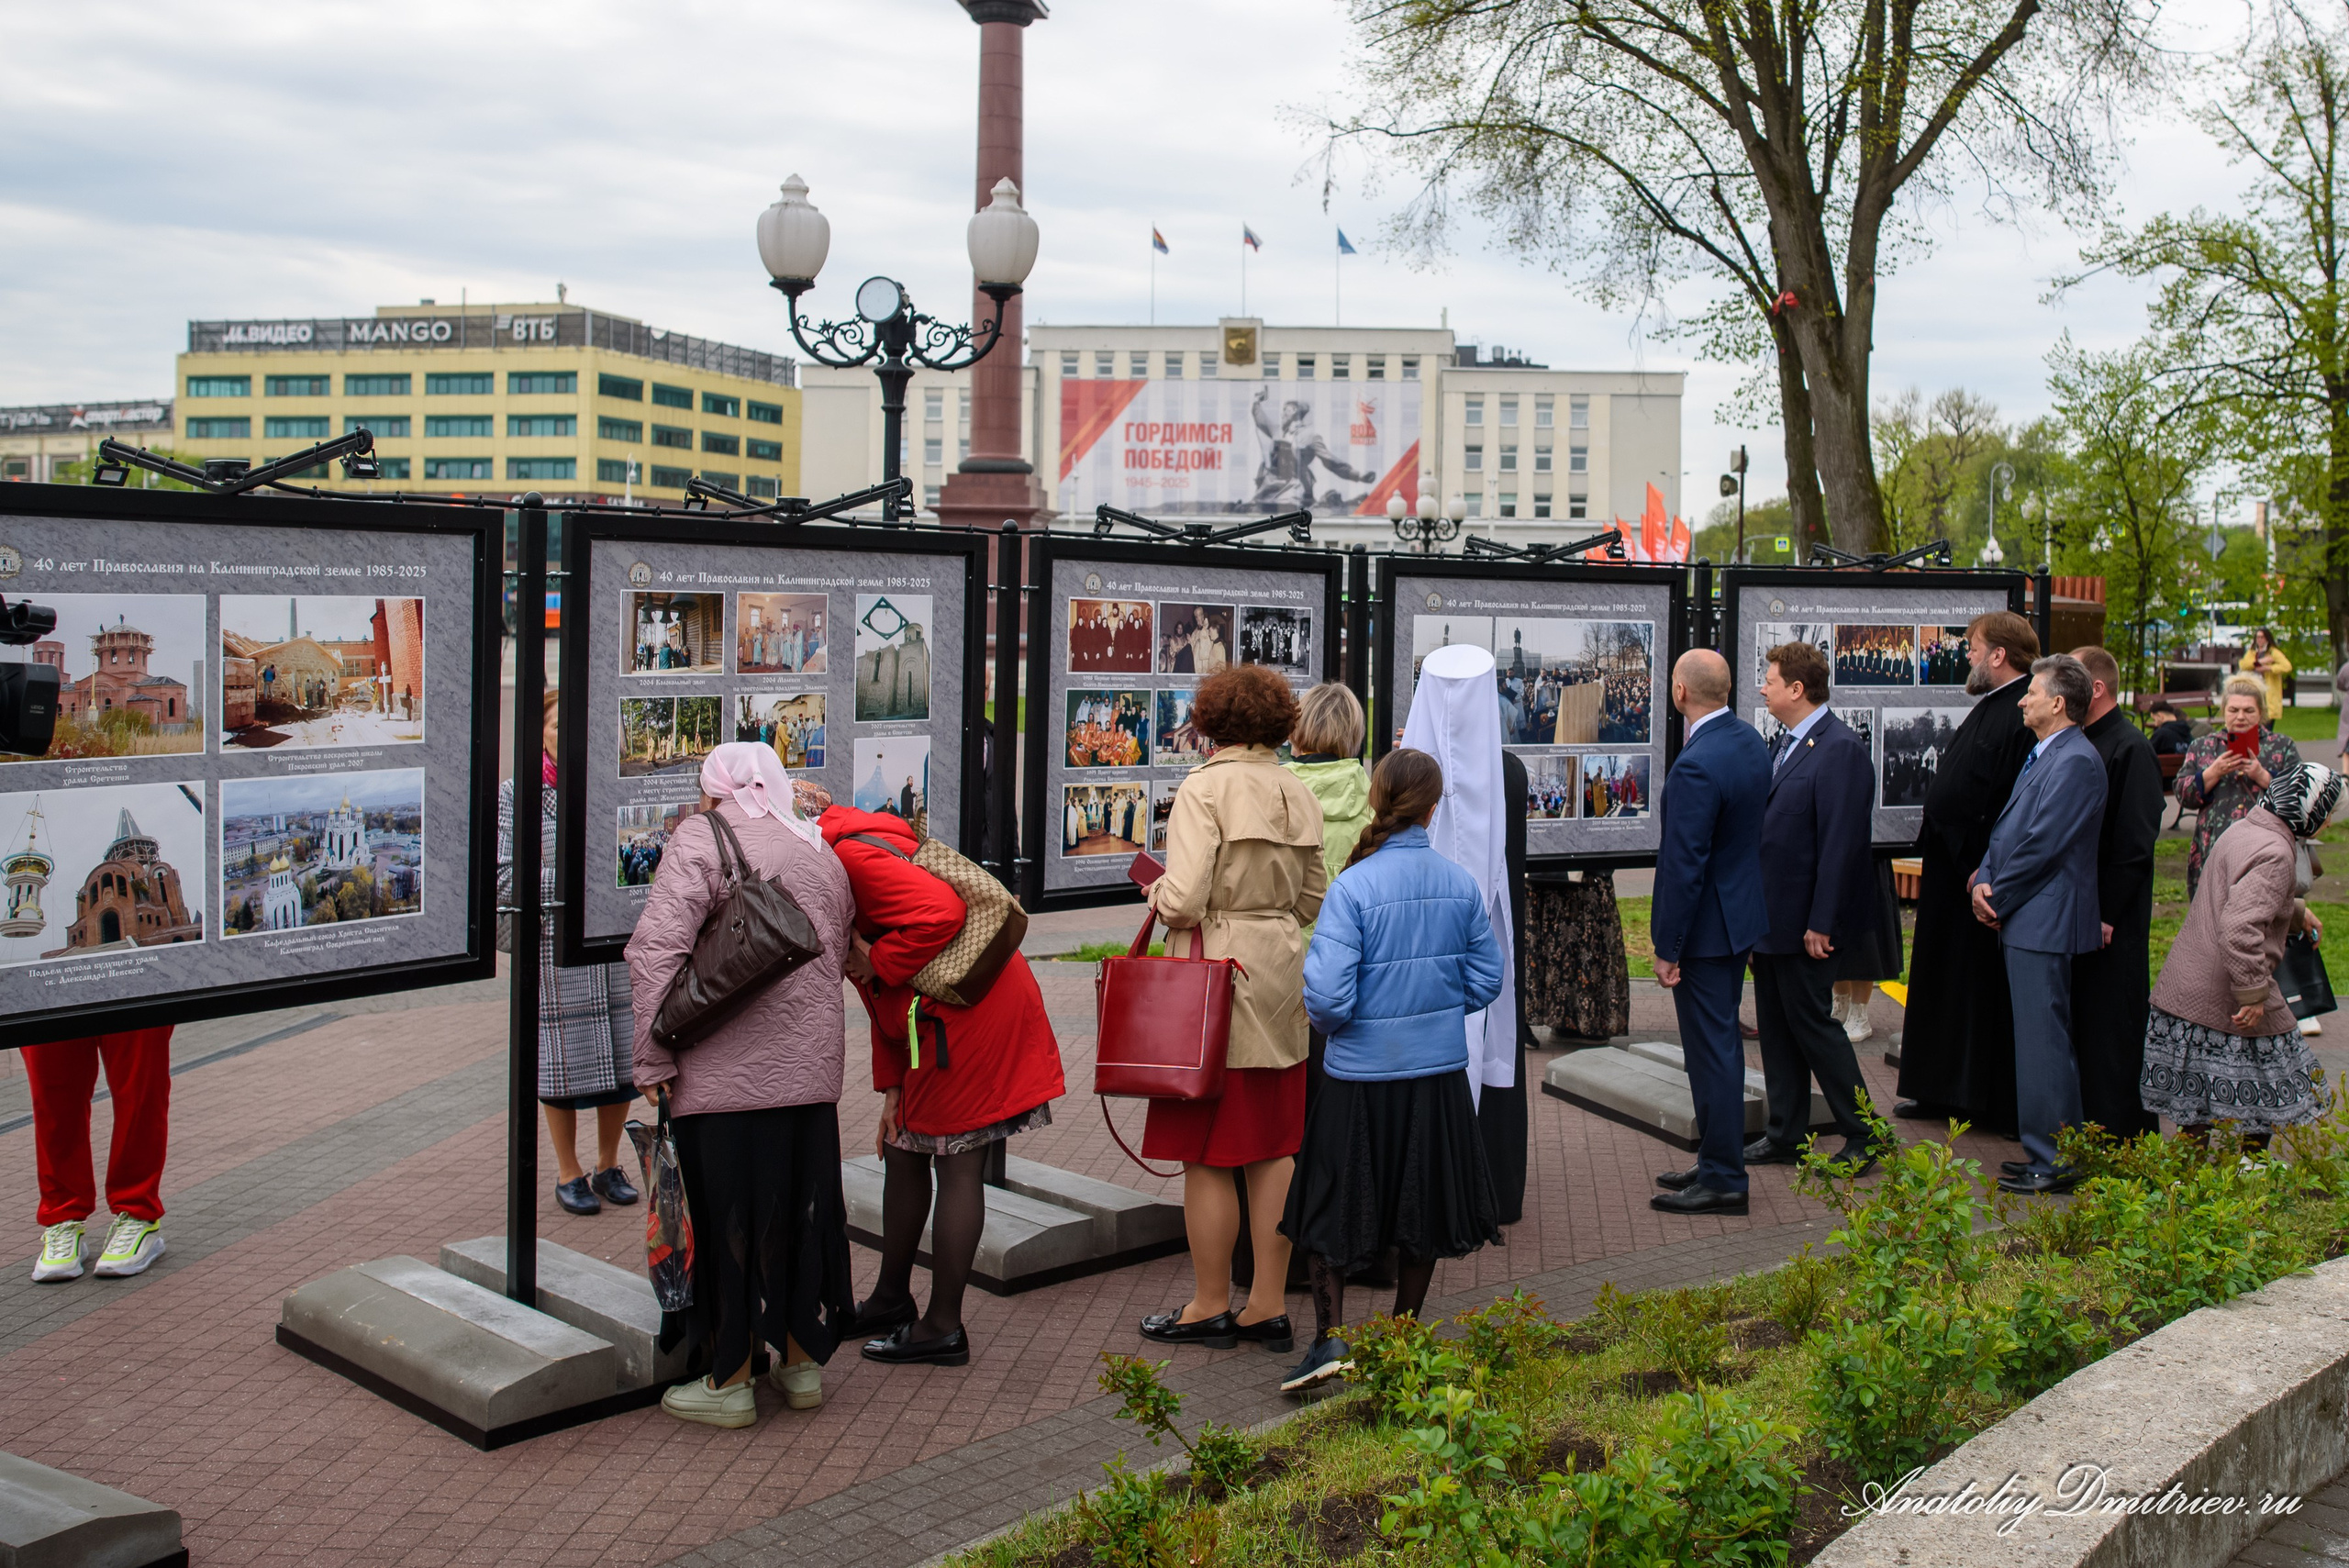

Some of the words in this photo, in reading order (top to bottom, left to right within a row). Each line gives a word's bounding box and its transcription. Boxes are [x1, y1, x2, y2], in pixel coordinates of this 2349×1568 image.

[350, 320, 452, 343] MANGO
[512, 318, 555, 341] ВТБ
[1124, 422, 1232, 446] ГОРДИМСЯ
[1124, 447, 1222, 473] ПОБЕДОЙ!
[34, 557, 54, 572] 40
[59, 562, 87, 572] лет
[93, 559, 184, 575] Православия
[189, 563, 205, 573] на
[210, 562, 320, 578] Калининградской
[325, 566, 362, 576] земле
[366, 564, 427, 577] 1985-2025
[659, 571, 673, 583] 40
[676, 574, 695, 583] лет
[698, 572, 760, 586] Православия
[763, 576, 774, 584] на
[778, 574, 854, 587] Калининградской
[886, 577, 930, 588] 1985-2025
[1107, 581, 1117, 590] 40
[1135, 583, 1179, 594] Православия
[1192, 585, 1248, 597] Калининградской
[1272, 589, 1304, 599] 1985-2025
[1447, 599, 1457, 607] 40
[1475, 600, 1519, 610] Православия
[1531, 601, 1588, 612] Калининградской
[1612, 604, 1646, 613] 1985-2025
[1789, 605, 1799, 613] 40
[1816, 605, 1859, 615] Православия
[1871, 606, 1928, 616] Калининградской
[1952, 606, 1986, 615] 1985-2025
[268, 753, 322, 763] Строительство
[288, 762, 328, 772] Покровский
[348, 759, 364, 768] 2007
[64, 764, 128, 774] Строительство
[62, 777, 88, 786] храма
[90, 774, 129, 784] Сретения
[264, 933, 317, 948] Кафедральный
[318, 932, 337, 941] собор
[338, 929, 362, 938] Христа
[364, 925, 399, 934] Спасителя
[280, 944, 324, 956] Калининград
[326, 937, 372, 949] Современный
[373, 935, 385, 943] вид
[64, 963, 92, 974] купола
[94, 959, 133, 971] будущего
[135, 955, 159, 965] храма
[44, 978, 56, 986] св.
[59, 973, 106, 984] Александра
[108, 967, 144, 978] Невского
